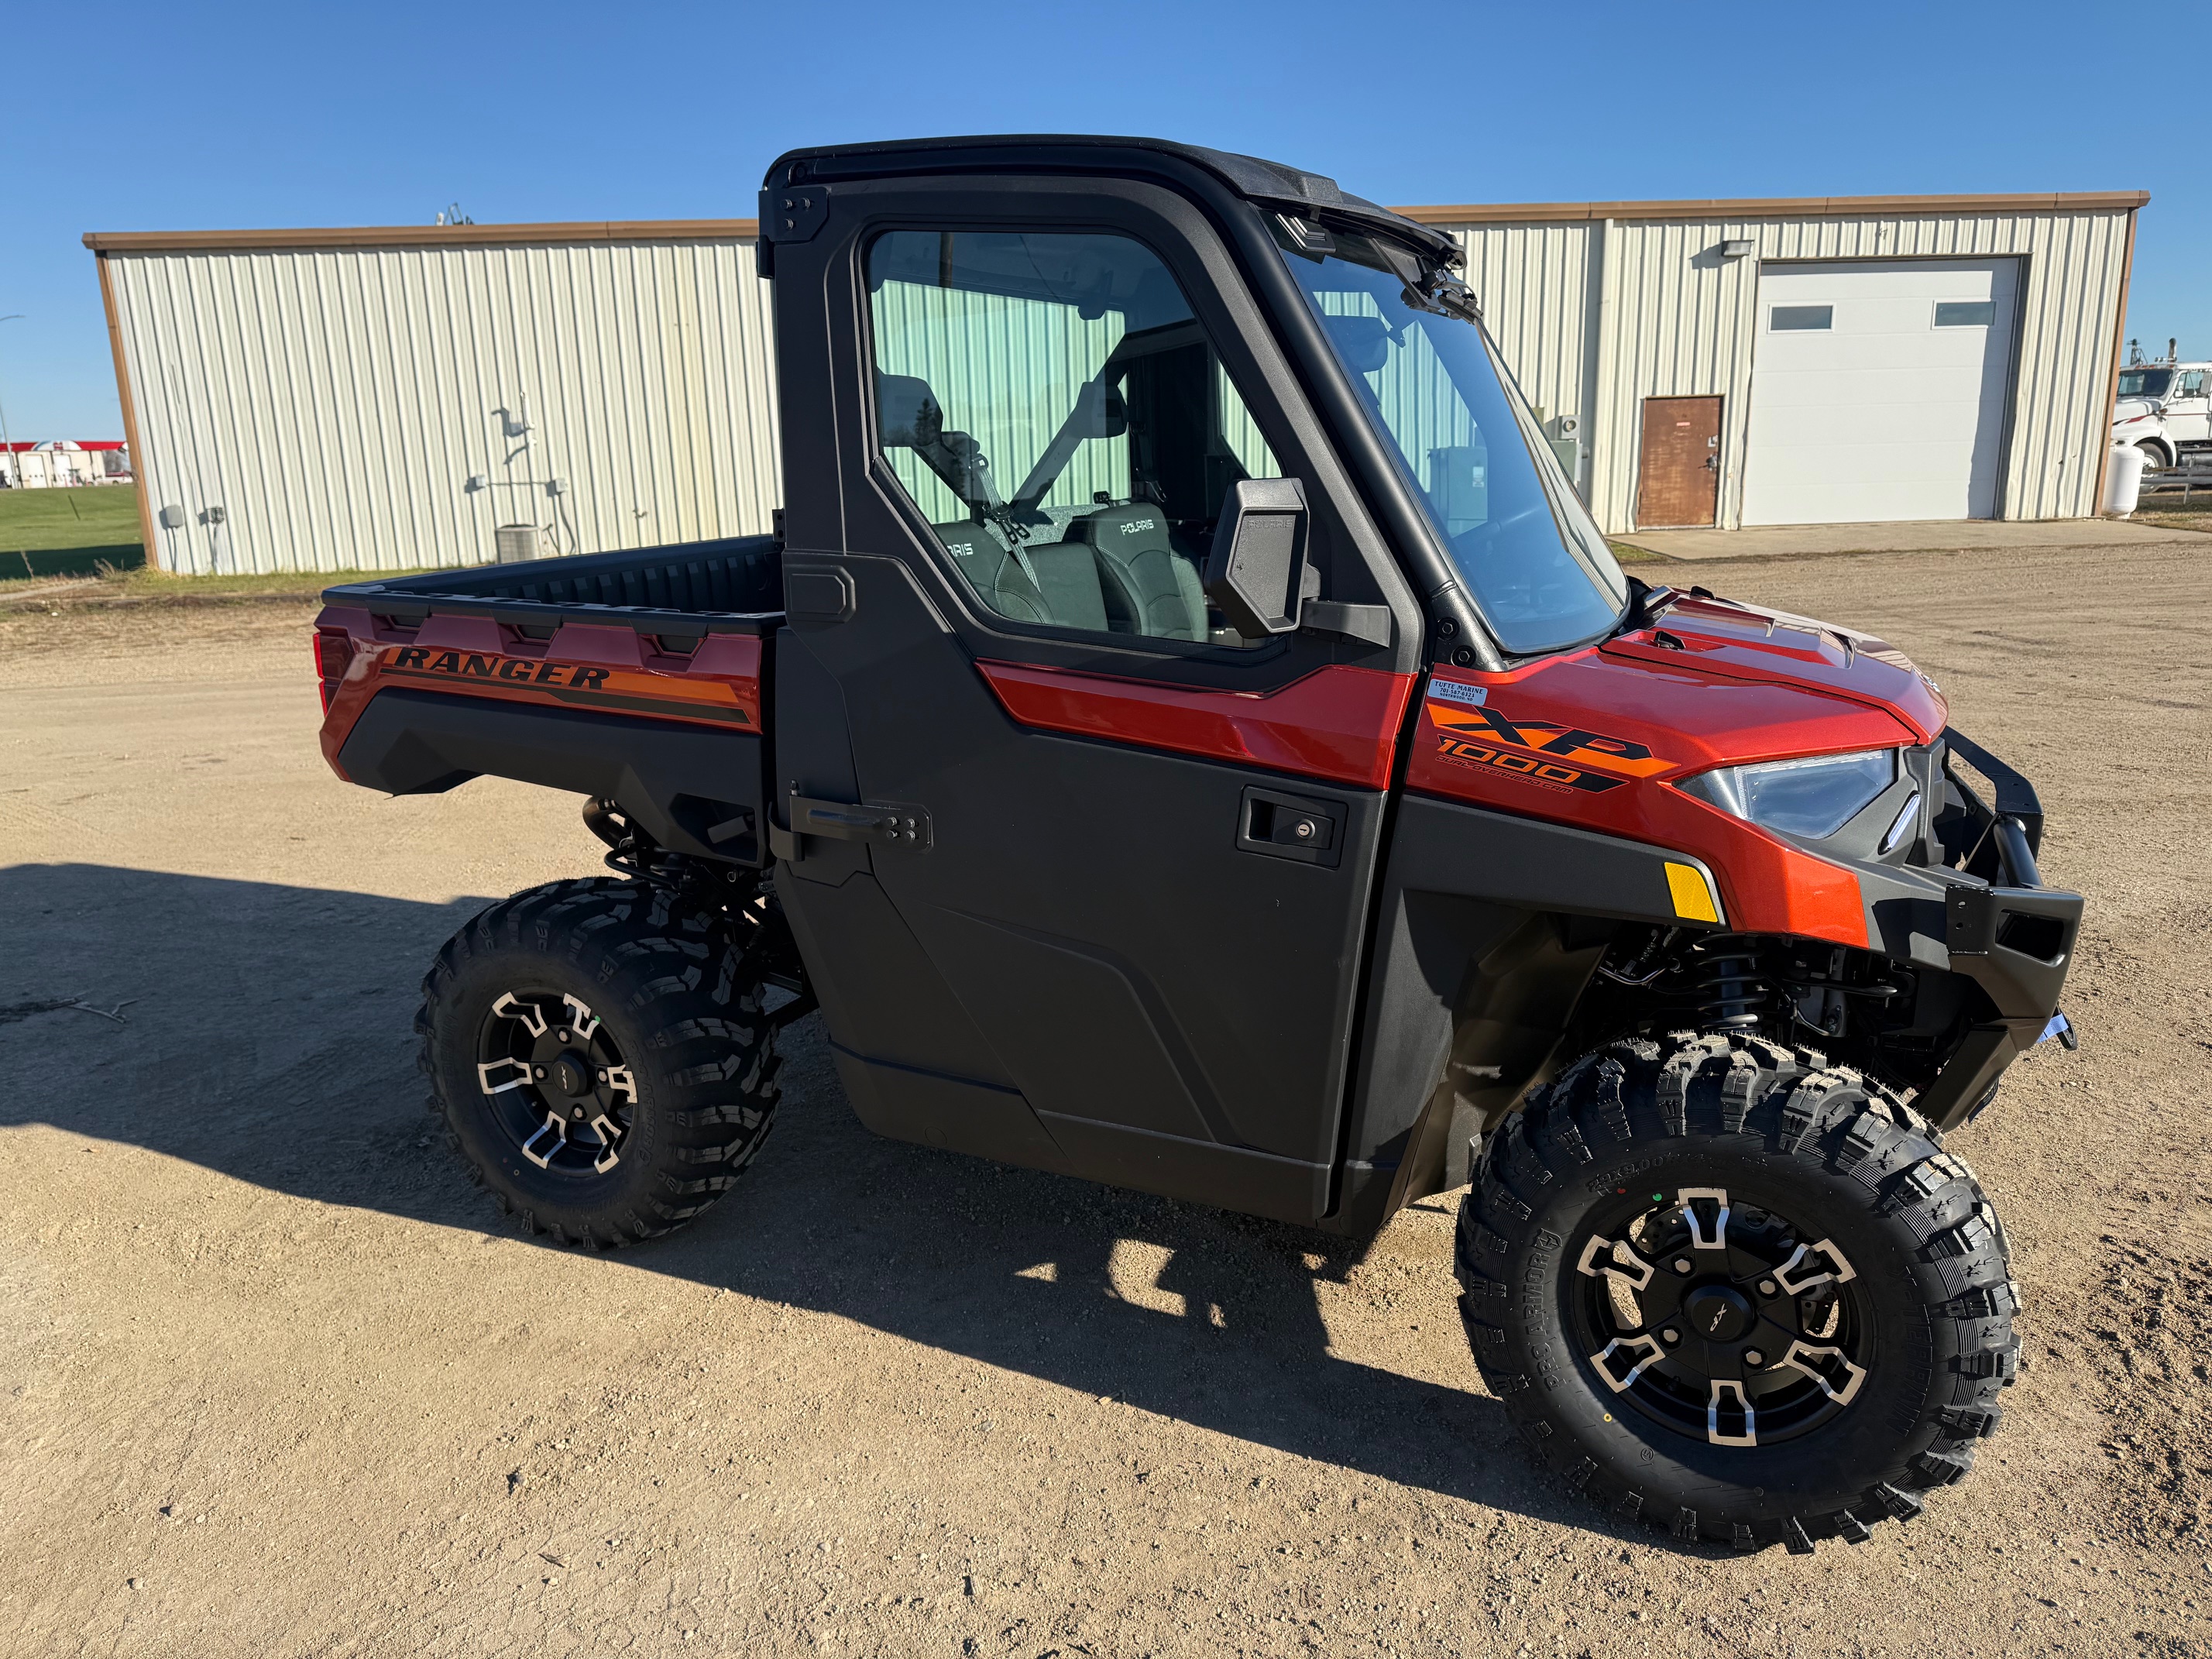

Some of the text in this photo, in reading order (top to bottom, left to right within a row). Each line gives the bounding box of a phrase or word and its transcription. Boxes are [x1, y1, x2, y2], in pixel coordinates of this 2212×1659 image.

[1120, 519, 1155, 536] POLARIS
[1248, 518, 1294, 529] POLARIS
[394, 647, 610, 690] RANGER
[1435, 681, 1484, 695] TUFTE MARINE
[1437, 705, 1654, 760] XP
[1436, 755, 1573, 794] DUAL OVERHEAD CAM
[1437, 739, 1581, 783] 1000
[1522, 1252, 1566, 1392] PRO ARMOR
[1885, 1266, 1932, 1437] X-TERRAIN
